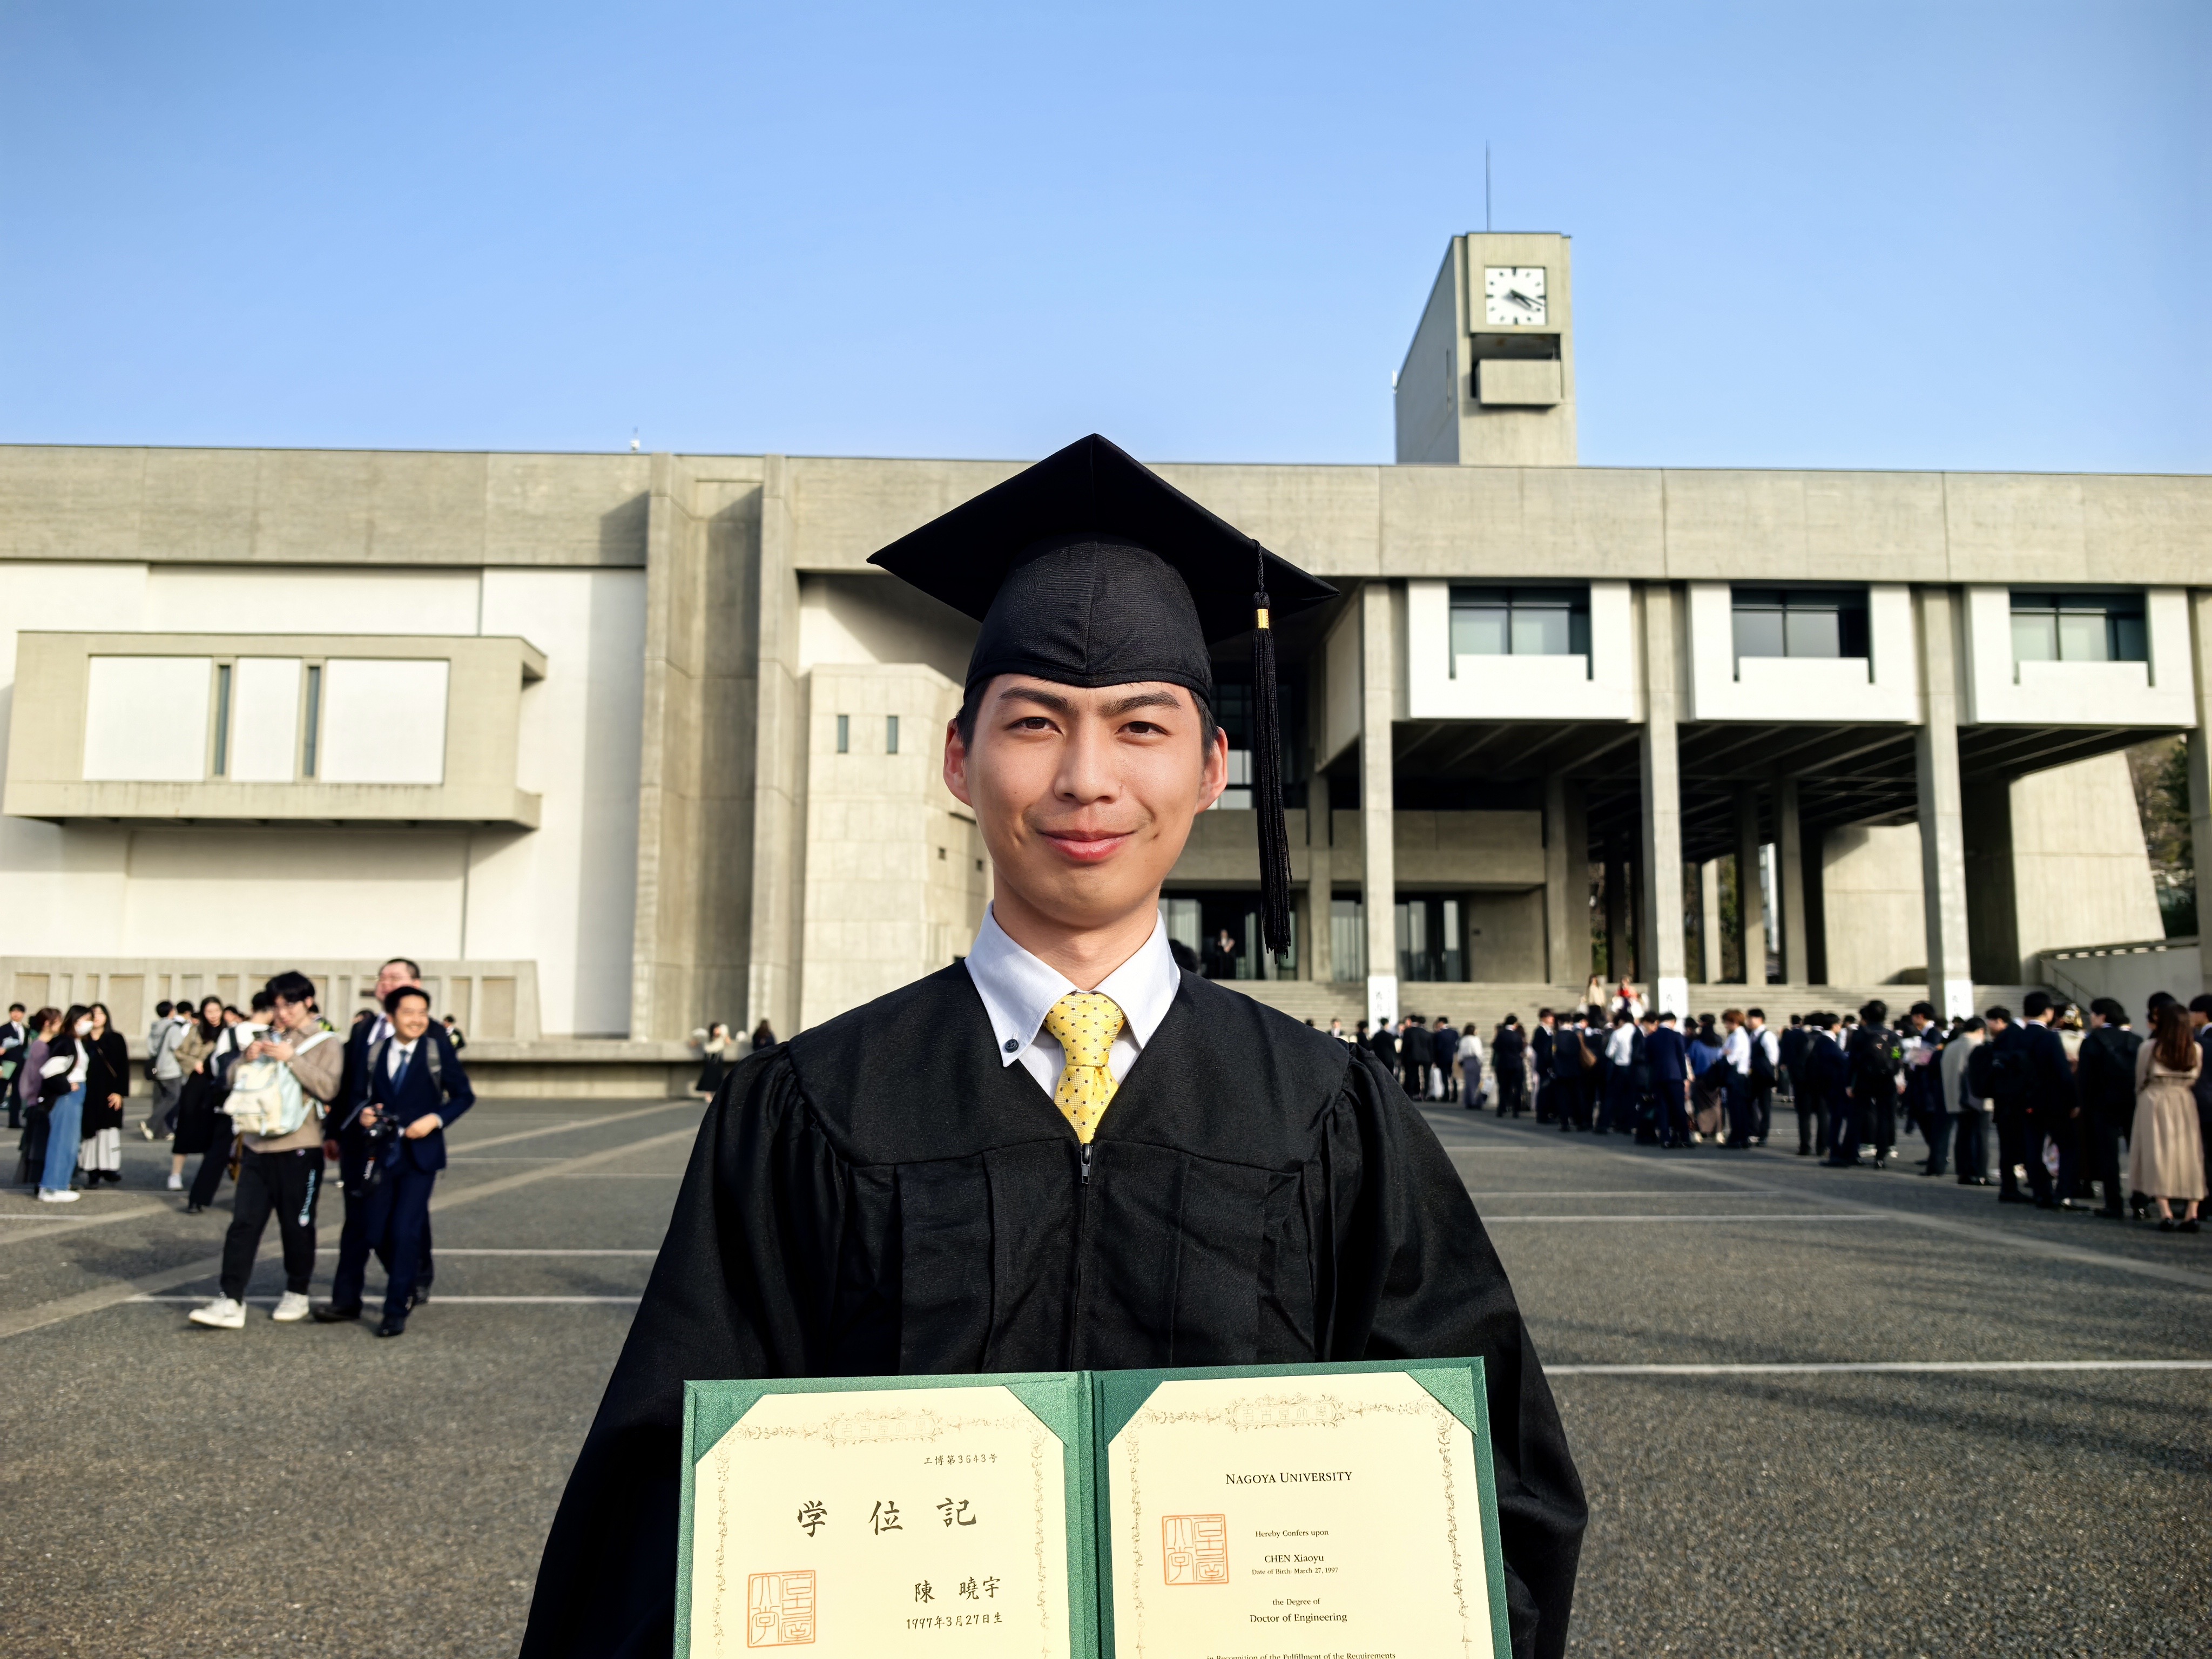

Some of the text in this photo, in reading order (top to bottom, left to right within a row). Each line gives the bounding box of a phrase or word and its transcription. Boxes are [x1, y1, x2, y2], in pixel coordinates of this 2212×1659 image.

[923, 1453, 997, 1466] 工博第3643号
[1226, 1472, 1352, 1485] NAGOYA UNIVERSITY
[797, 1498, 976, 1537] 学位記
[1255, 1530, 1280, 1539] Hereby
[1264, 1554, 1324, 1564] CHEN Xiaoyu
[915, 1580, 935, 1603] 陳
[1286, 1599, 1311, 1607] Degree
[907, 1612, 1003, 1630] 1997年3月27日生
[1250, 1613, 1347, 1623] Doctor of Engineering
